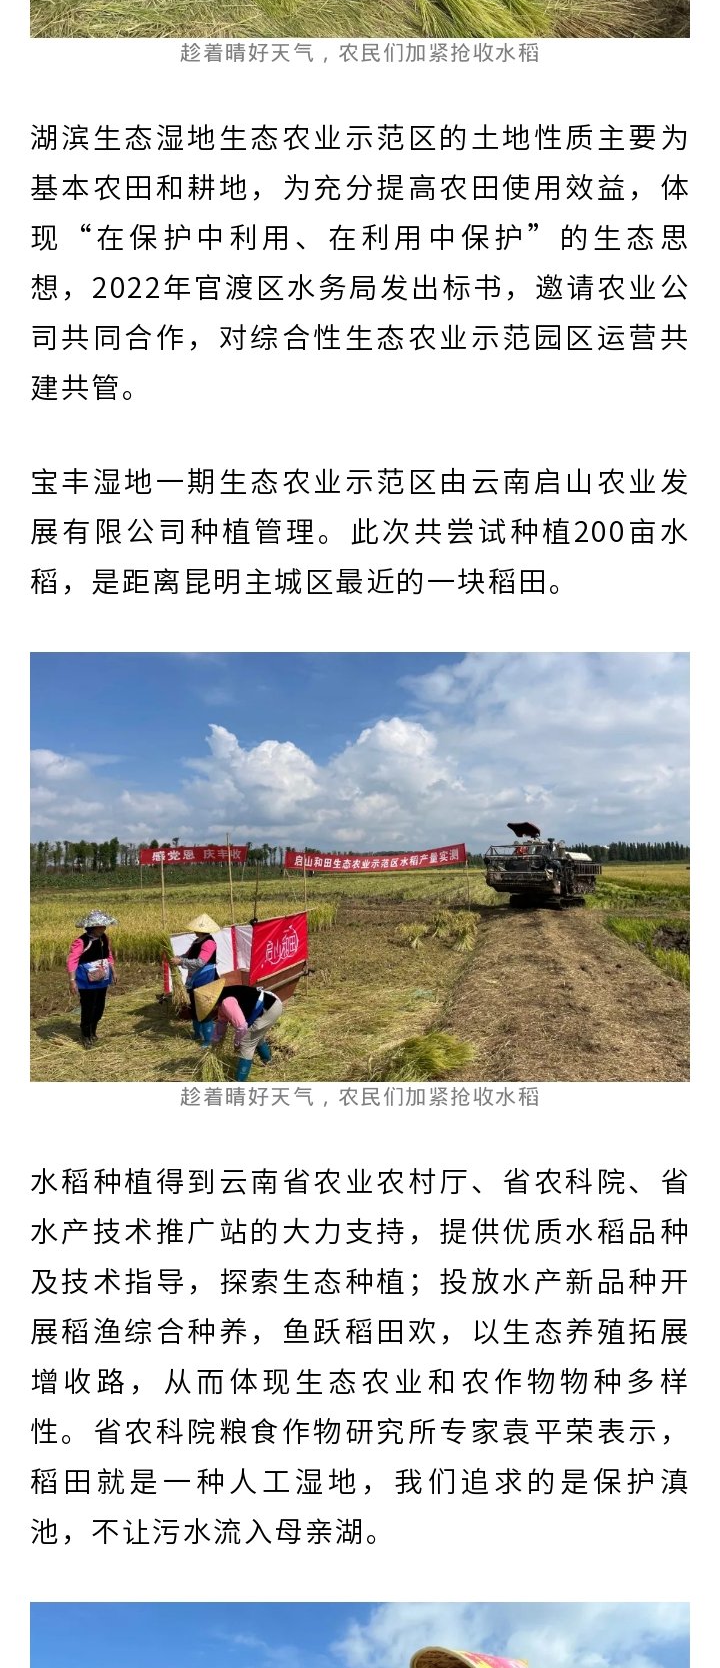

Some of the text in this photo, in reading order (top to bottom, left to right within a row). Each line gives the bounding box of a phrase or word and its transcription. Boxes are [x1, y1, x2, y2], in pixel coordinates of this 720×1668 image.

[152, 849, 241, 861] 感党恩 庆丰收
